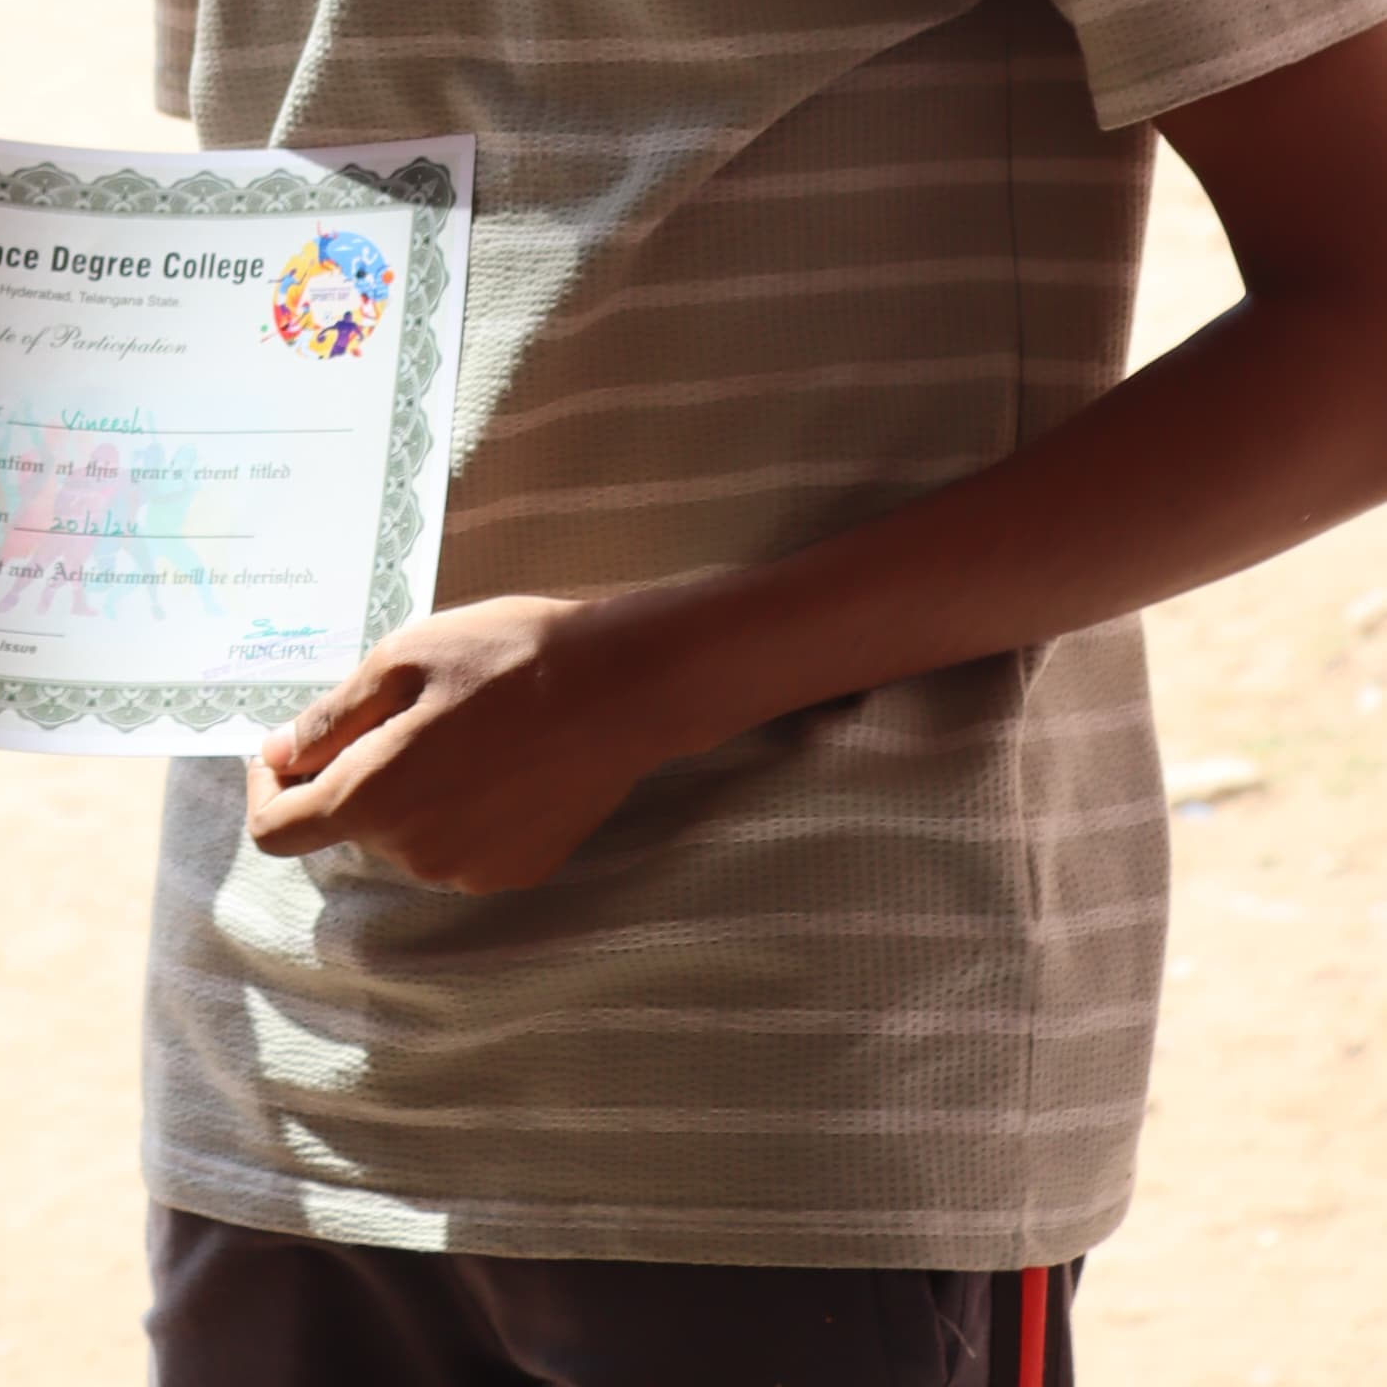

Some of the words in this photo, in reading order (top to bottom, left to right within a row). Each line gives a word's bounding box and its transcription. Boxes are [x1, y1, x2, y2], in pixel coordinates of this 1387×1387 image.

[51, 245, 151, 281] Degree
[163, 252, 264, 285] College
[21, 327, 48, 354] of
[50, 325, 187, 361] Participation
[55, 461, 74, 476] at
[85, 460, 119, 482] this
[194, 461, 239, 480] event
[249, 460, 291, 479] titled
[9, 563, 44, 579] and
[51, 561, 167, 588] Achievement
[173, 569, 204, 585] will
[210, 568, 228, 585] be
[229, 645, 317, 660] PRINCIPAL
